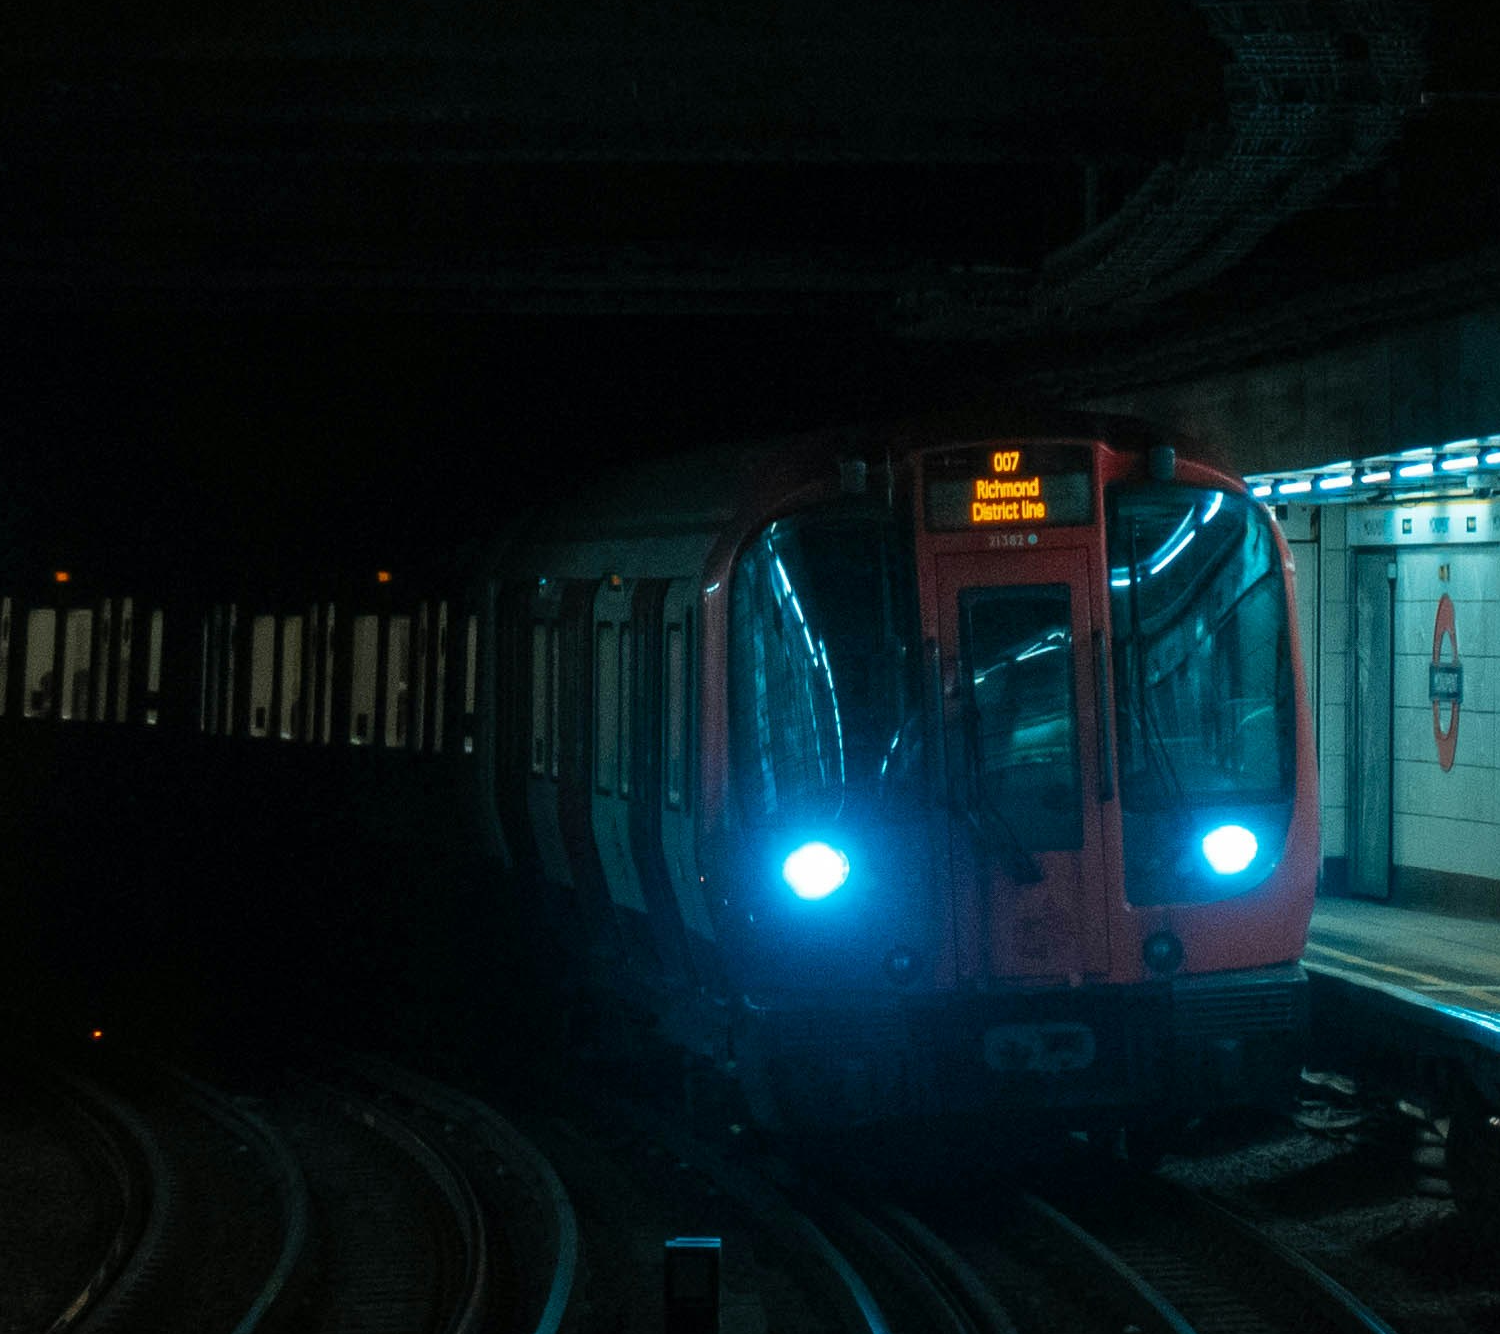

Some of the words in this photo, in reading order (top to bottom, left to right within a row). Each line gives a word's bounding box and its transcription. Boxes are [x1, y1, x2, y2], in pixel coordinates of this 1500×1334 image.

[992, 451, 1020, 472] 007
[974, 476, 1040, 499] Richmond
[972, 500, 1020, 523] District
[1021, 499, 1046, 520] line
